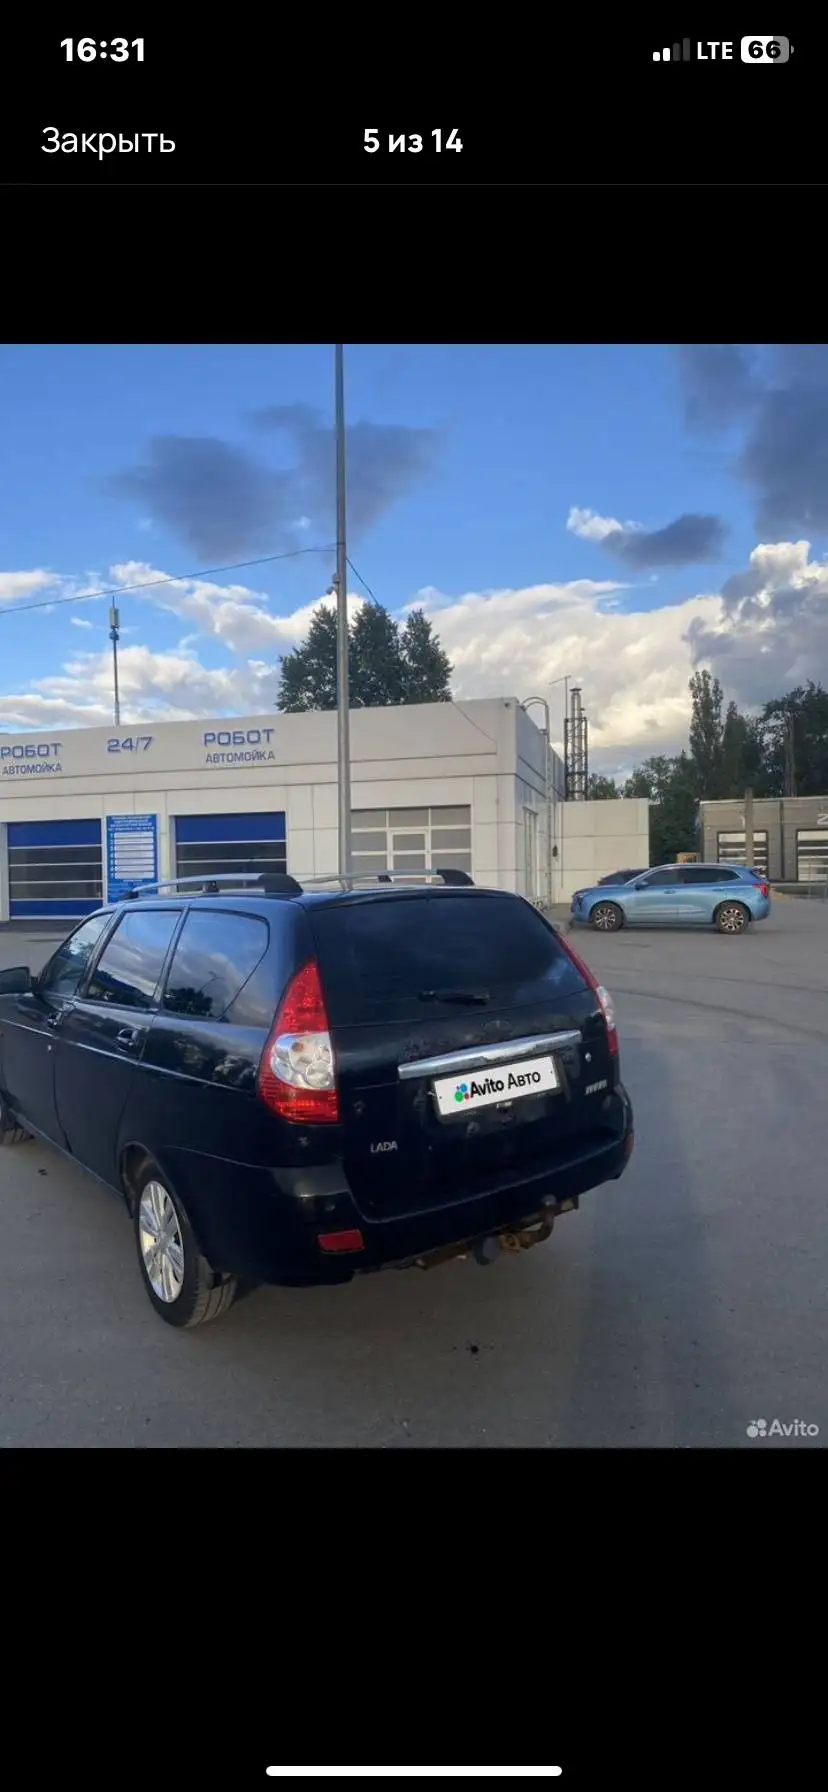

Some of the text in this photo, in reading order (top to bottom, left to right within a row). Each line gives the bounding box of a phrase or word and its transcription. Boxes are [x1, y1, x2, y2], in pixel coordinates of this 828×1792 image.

[107, 736, 153, 755] 24/7
[203, 728, 275, 747] РОБОТ
[0, 742, 62, 760] РОБОТ
[205, 749, 276, 763] АВТОМОЙКА
[2, 761, 63, 775] АВТОМОЙКА
[370, 1140, 399, 1154] LADA
